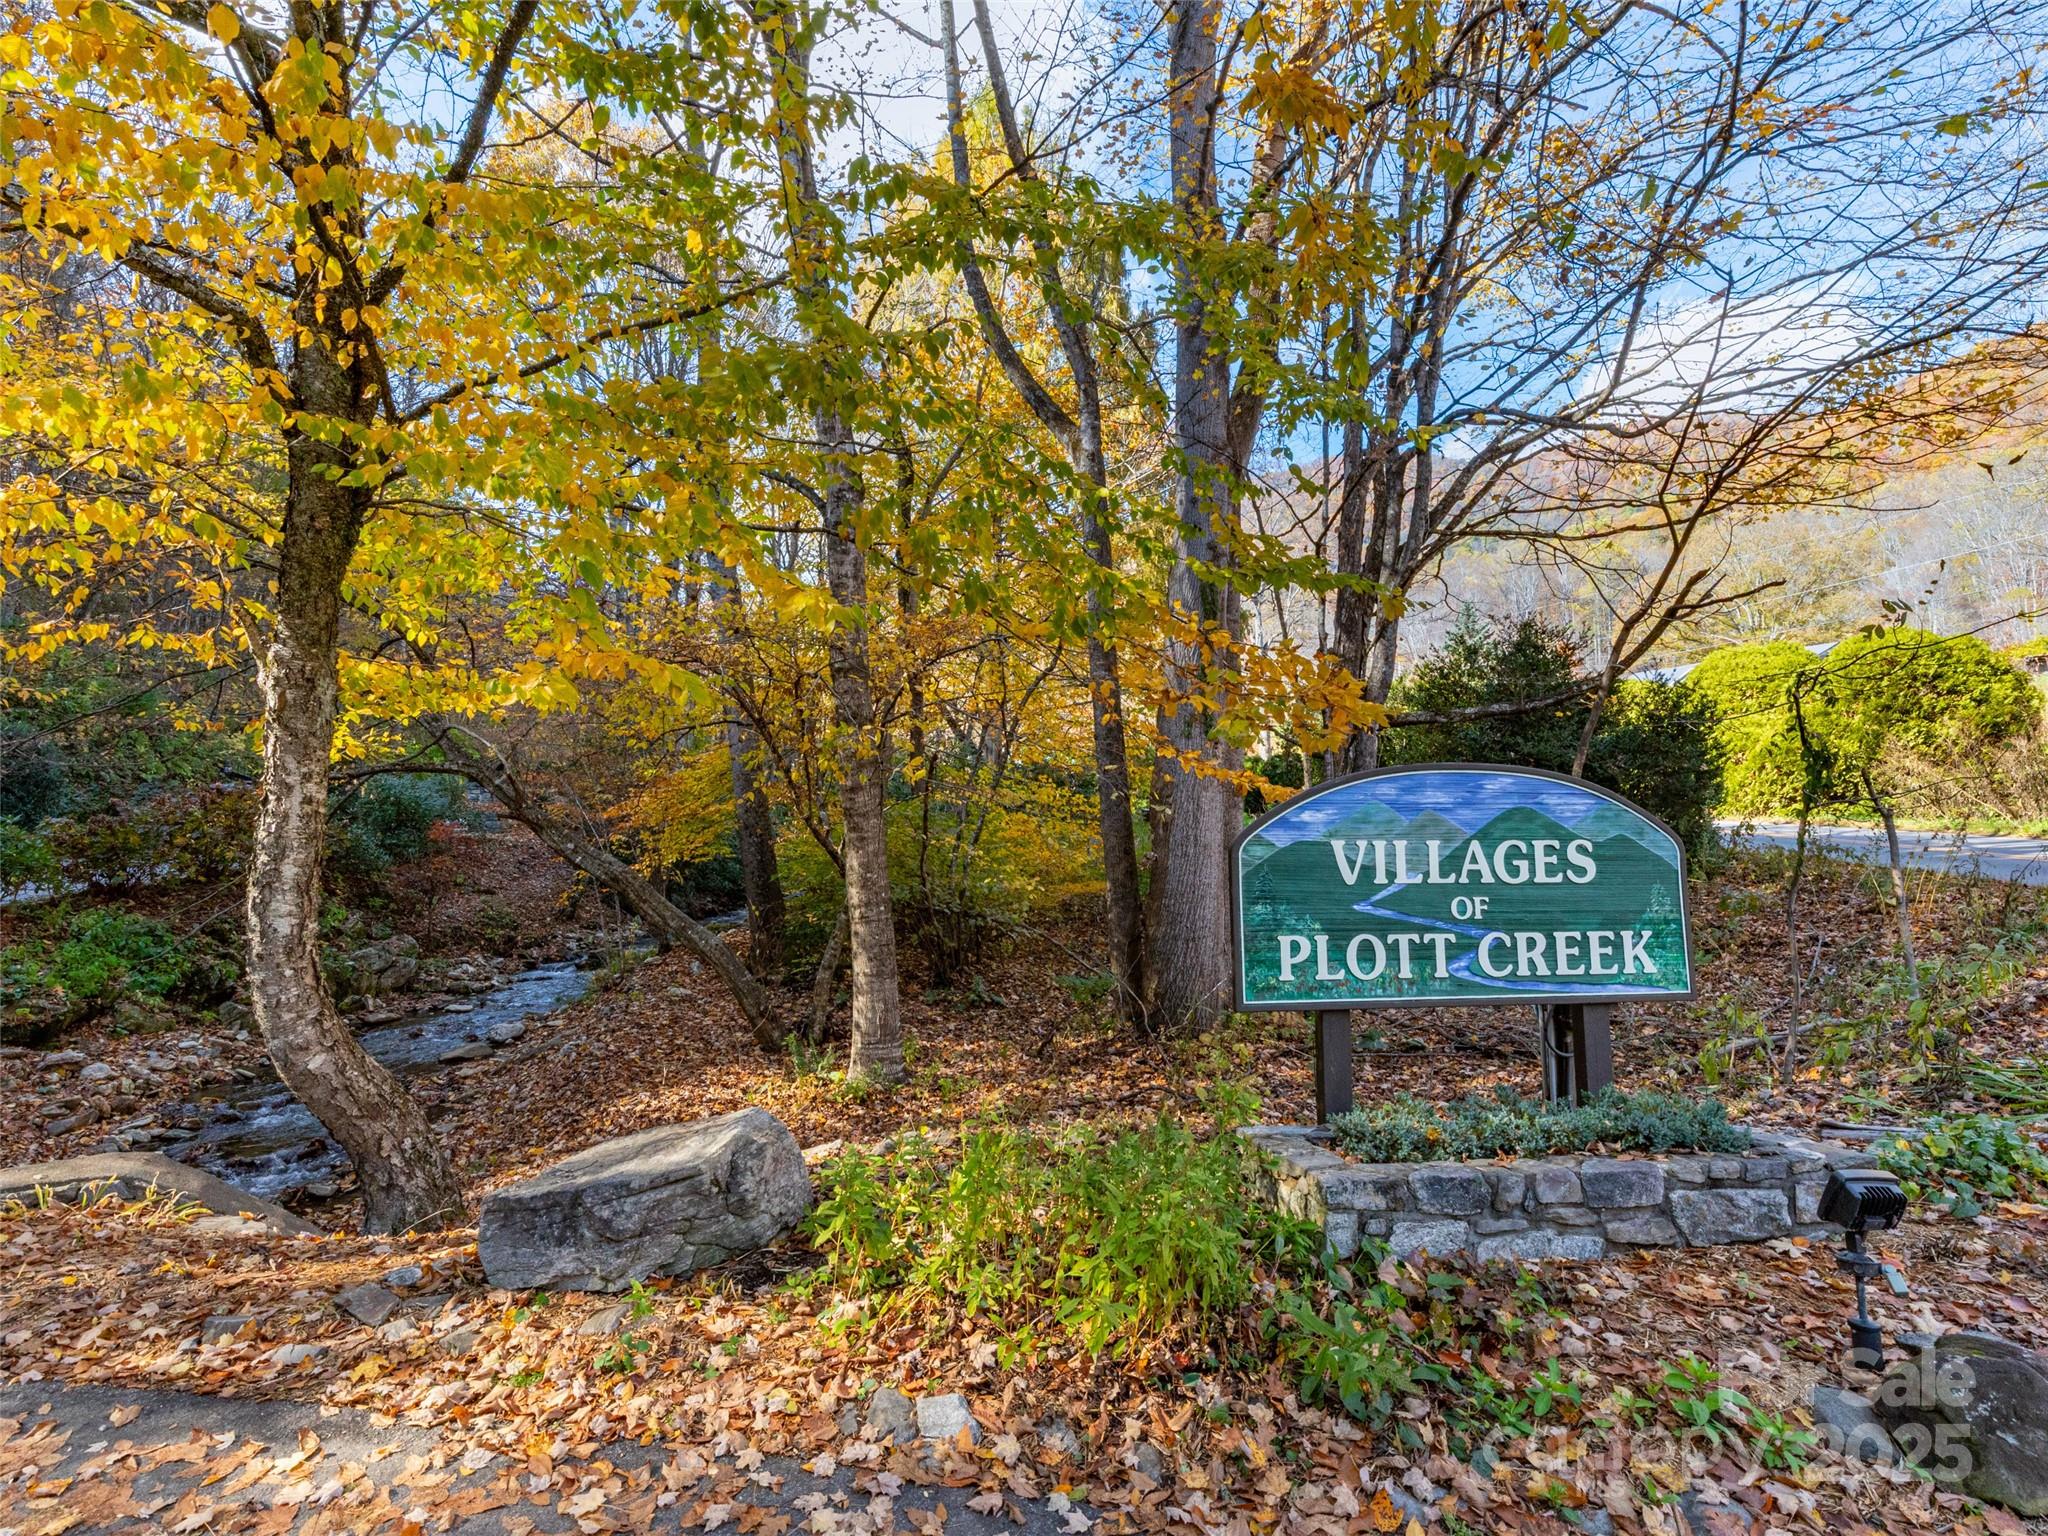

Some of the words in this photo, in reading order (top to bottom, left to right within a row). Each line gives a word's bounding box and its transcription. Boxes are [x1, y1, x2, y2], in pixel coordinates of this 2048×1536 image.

[1330, 839, 1597, 886] VILLAGES
[1450, 896, 1489, 920] OF
[1277, 933, 1455, 981] PLOTT
[1477, 930, 1657, 978] CREEK
